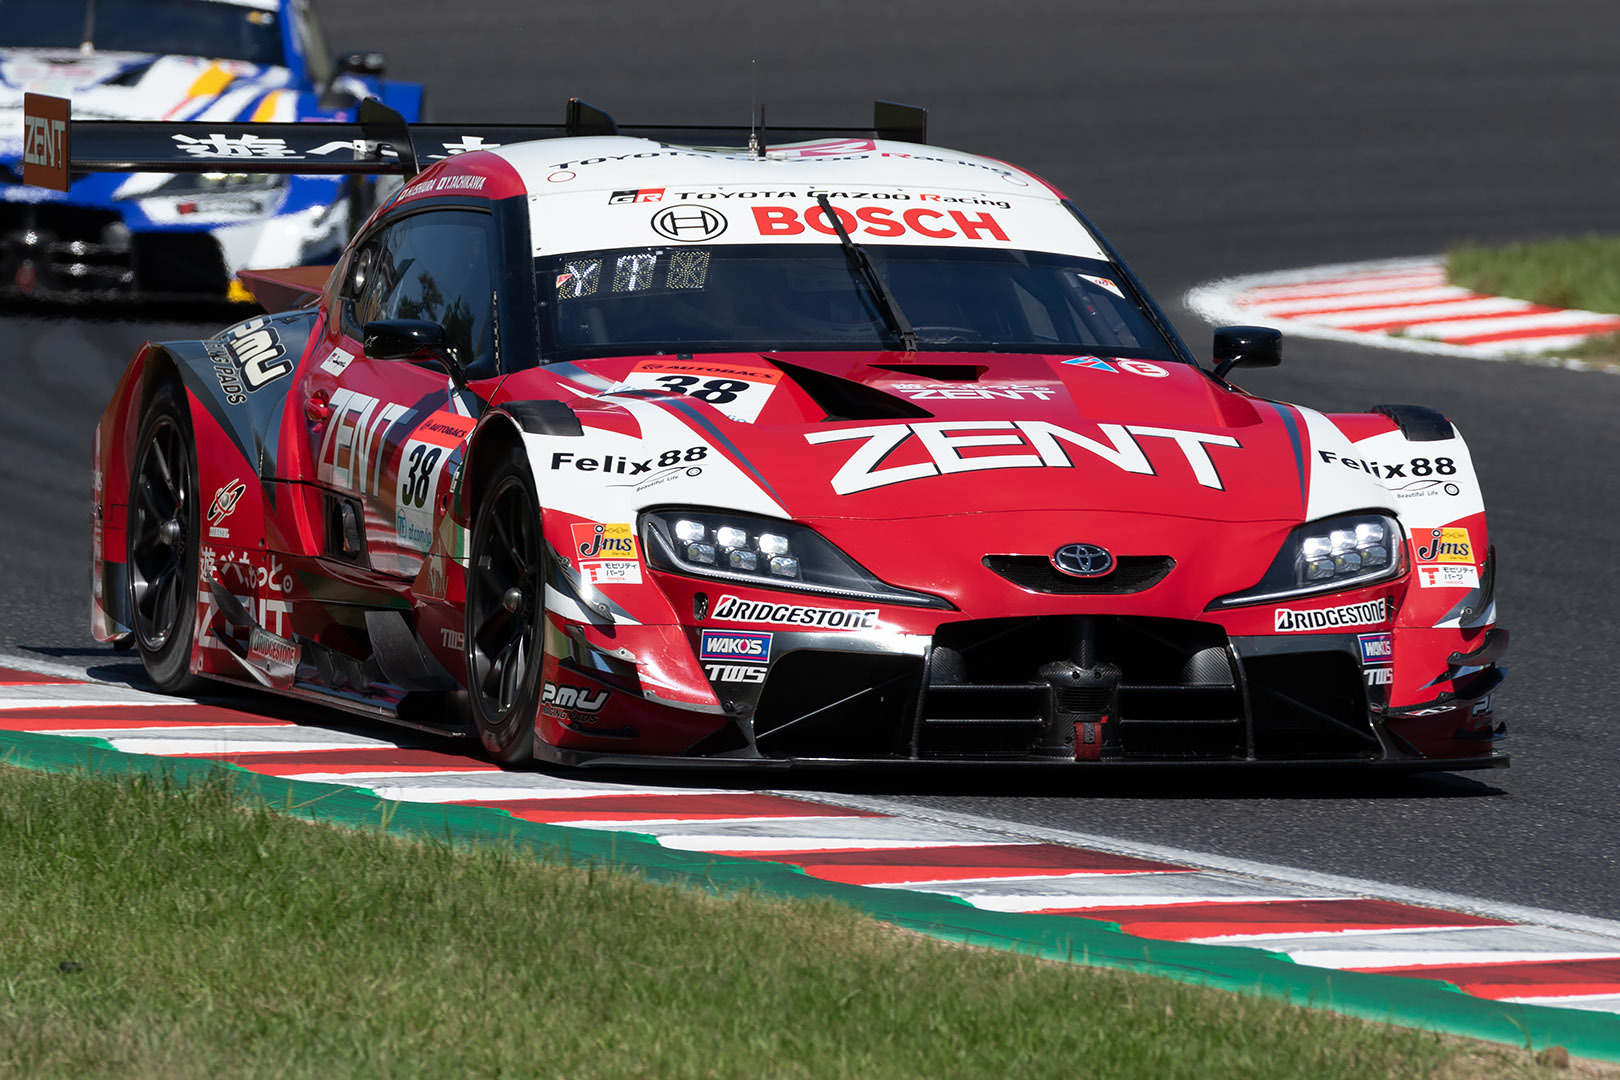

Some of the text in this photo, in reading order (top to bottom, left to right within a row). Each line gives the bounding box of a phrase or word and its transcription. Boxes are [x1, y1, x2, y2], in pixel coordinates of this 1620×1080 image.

[25, 115, 66, 169] ZENT
[674, 190, 797, 200] TOYOTA
[806, 189, 911, 201] GAZOO
[920, 193, 1011, 209] Racing
[751, 205, 1011, 242] BOSCH
[214, 365, 247, 405] PADS
[665, 366, 774, 379] AUTOBACS
[655, 375, 750, 404] 38
[899, 389, 1056, 401] ZENT
[317, 387, 419, 498] ZENT
[429, 423, 468, 439] AUTOBACS
[551, 446, 708, 476] Felix88
[804, 420, 1243, 496] ZENT
[1317, 449, 1457, 479] Felix88
[402, 444, 442, 509] 38
[580, 524, 632, 556] jms
[1418, 529, 1469, 560] jms
[714, 595, 876, 628] BRIDGESTONE
[1278, 599, 1386, 630] BRIDGESTONE
[253, 629, 295, 666] BRIDGESTONE
[705, 664, 768, 684] TWS
[1363, 667, 1394, 686] TWS
